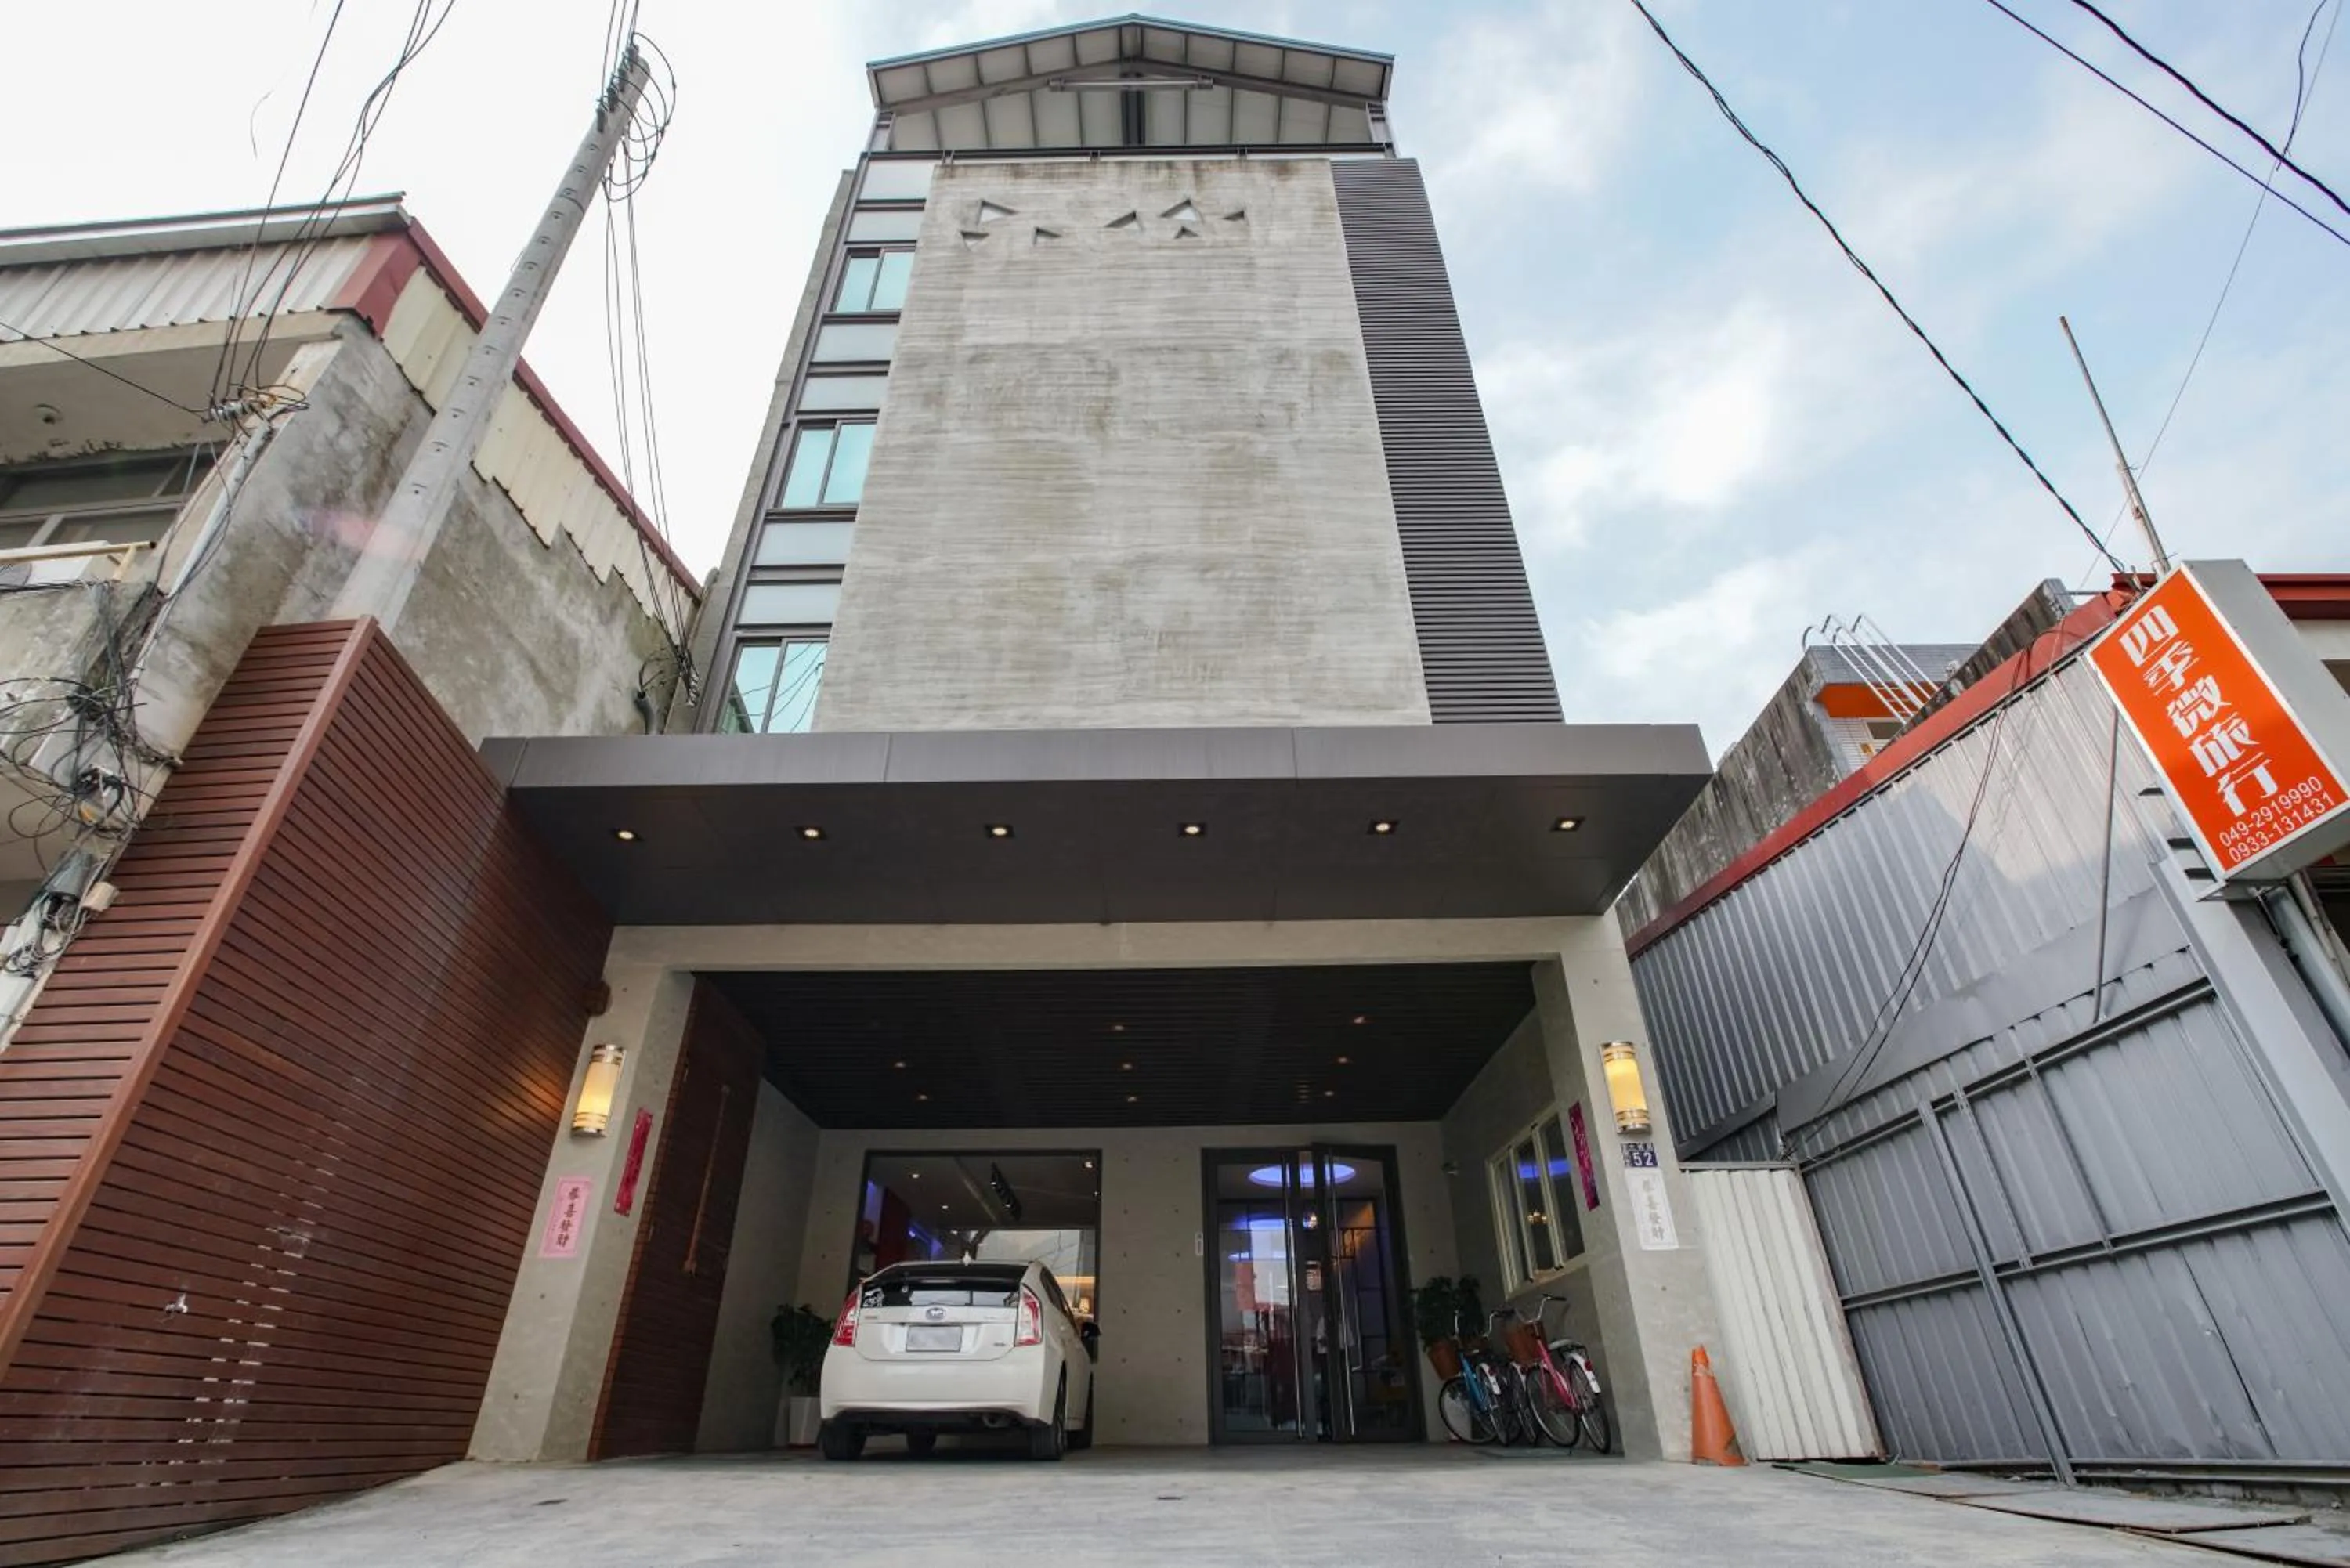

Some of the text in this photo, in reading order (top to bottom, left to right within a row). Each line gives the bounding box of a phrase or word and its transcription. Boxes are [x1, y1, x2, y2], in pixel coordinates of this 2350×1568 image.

[2119, 604, 2280, 818] 四季微旅行
[2219, 776, 2322, 847] 049-2919990
[2229, 791, 2335, 862] 0933-131431
[1632, 1152, 1654, 1166] 52
